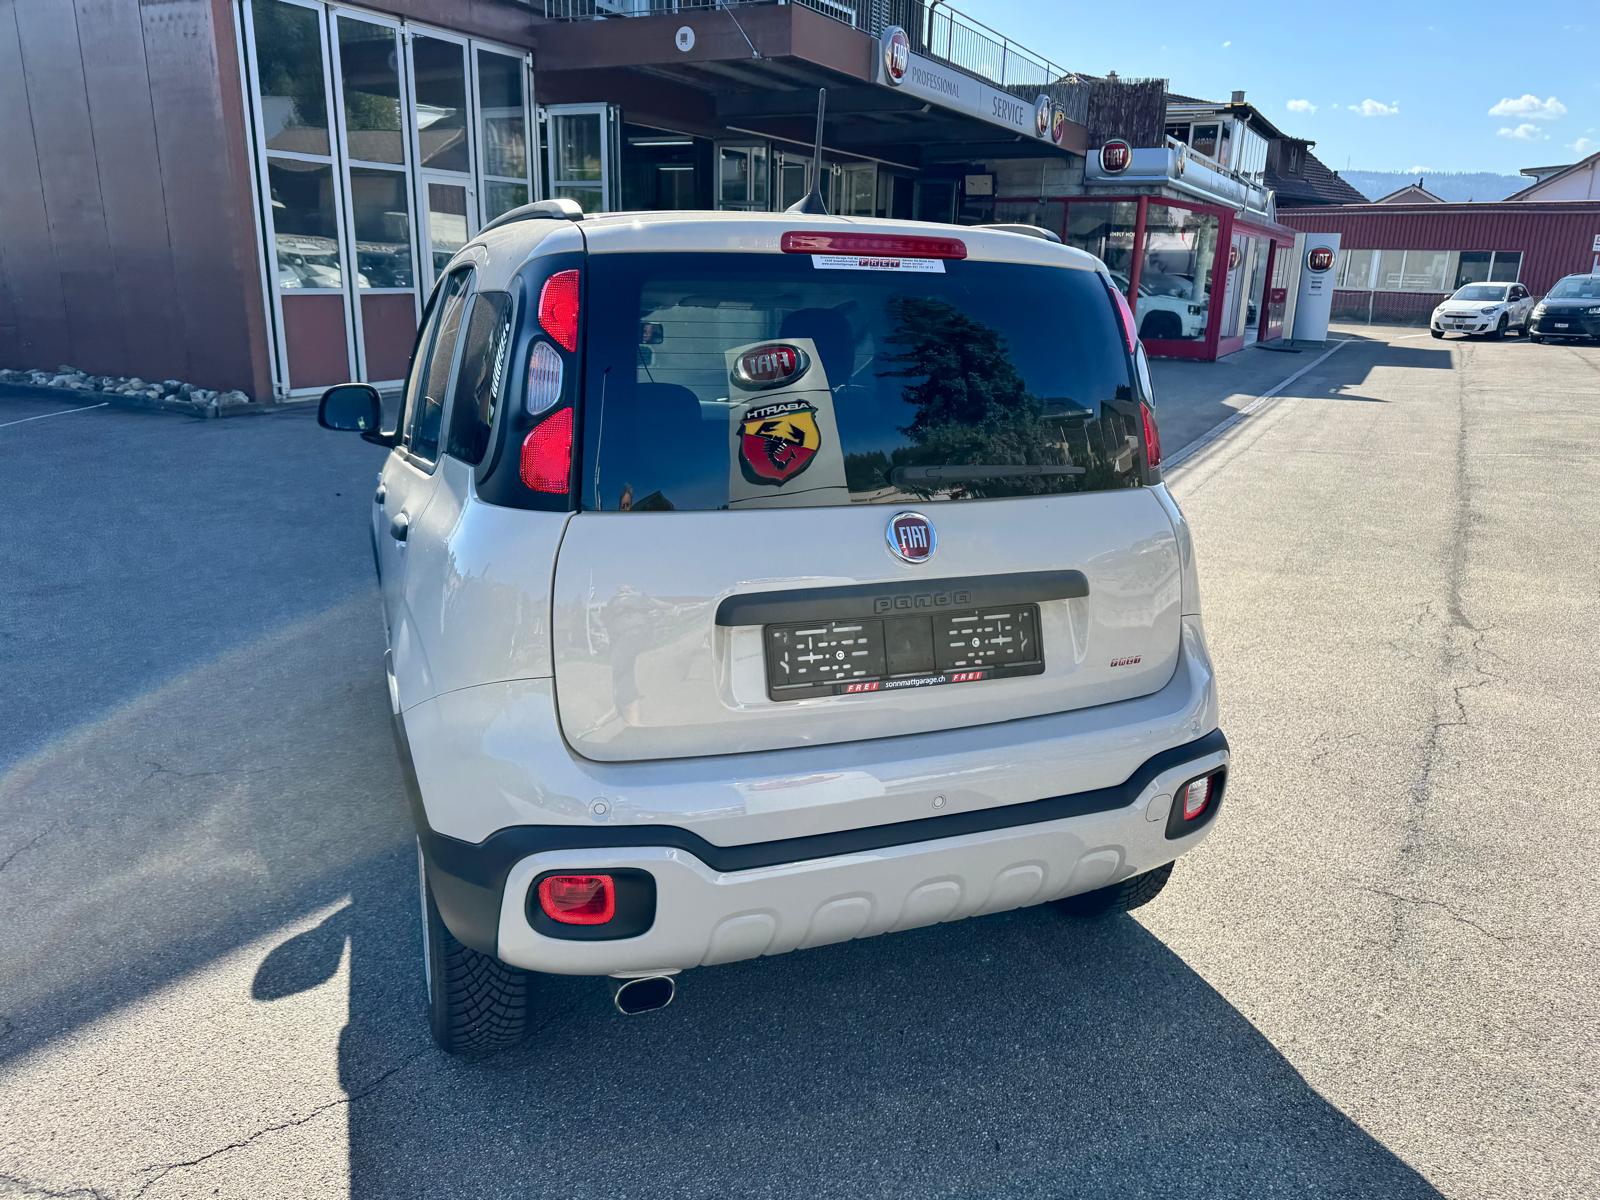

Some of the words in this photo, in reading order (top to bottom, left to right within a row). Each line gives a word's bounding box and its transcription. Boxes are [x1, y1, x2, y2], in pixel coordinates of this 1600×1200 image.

[911, 66, 960, 98] PROFESSIONAL
[992, 95, 1024, 126] SERVICE
[1104, 148, 1126, 166] FIAT
[898, 525, 928, 549] FIAT
[873, 590, 972, 615] panda
[847, 683, 877, 693] FREI
[885, 675, 946, 689] sonnmattgarage.ch
[953, 672, 982, 682] FREI
